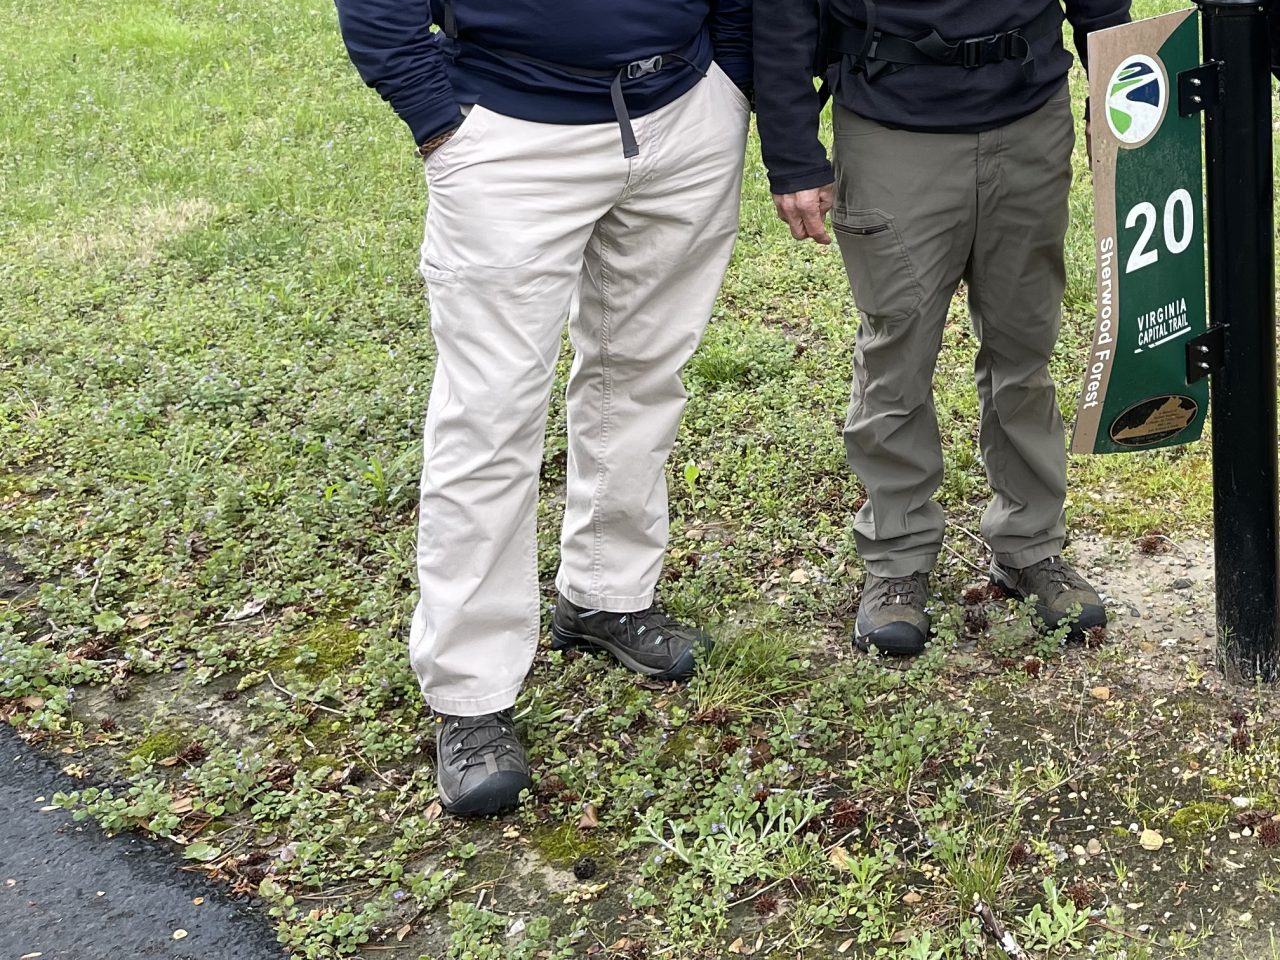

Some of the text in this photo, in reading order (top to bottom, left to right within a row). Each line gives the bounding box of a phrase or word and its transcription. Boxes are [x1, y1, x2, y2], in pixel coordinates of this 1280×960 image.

[1125, 188, 1194, 274] 20
[1083, 236, 1114, 409] Sherwood Forest
[1137, 297, 1187, 331] VIRGINIA
[1138, 312, 1189, 346] CAPITAL TRAIL
